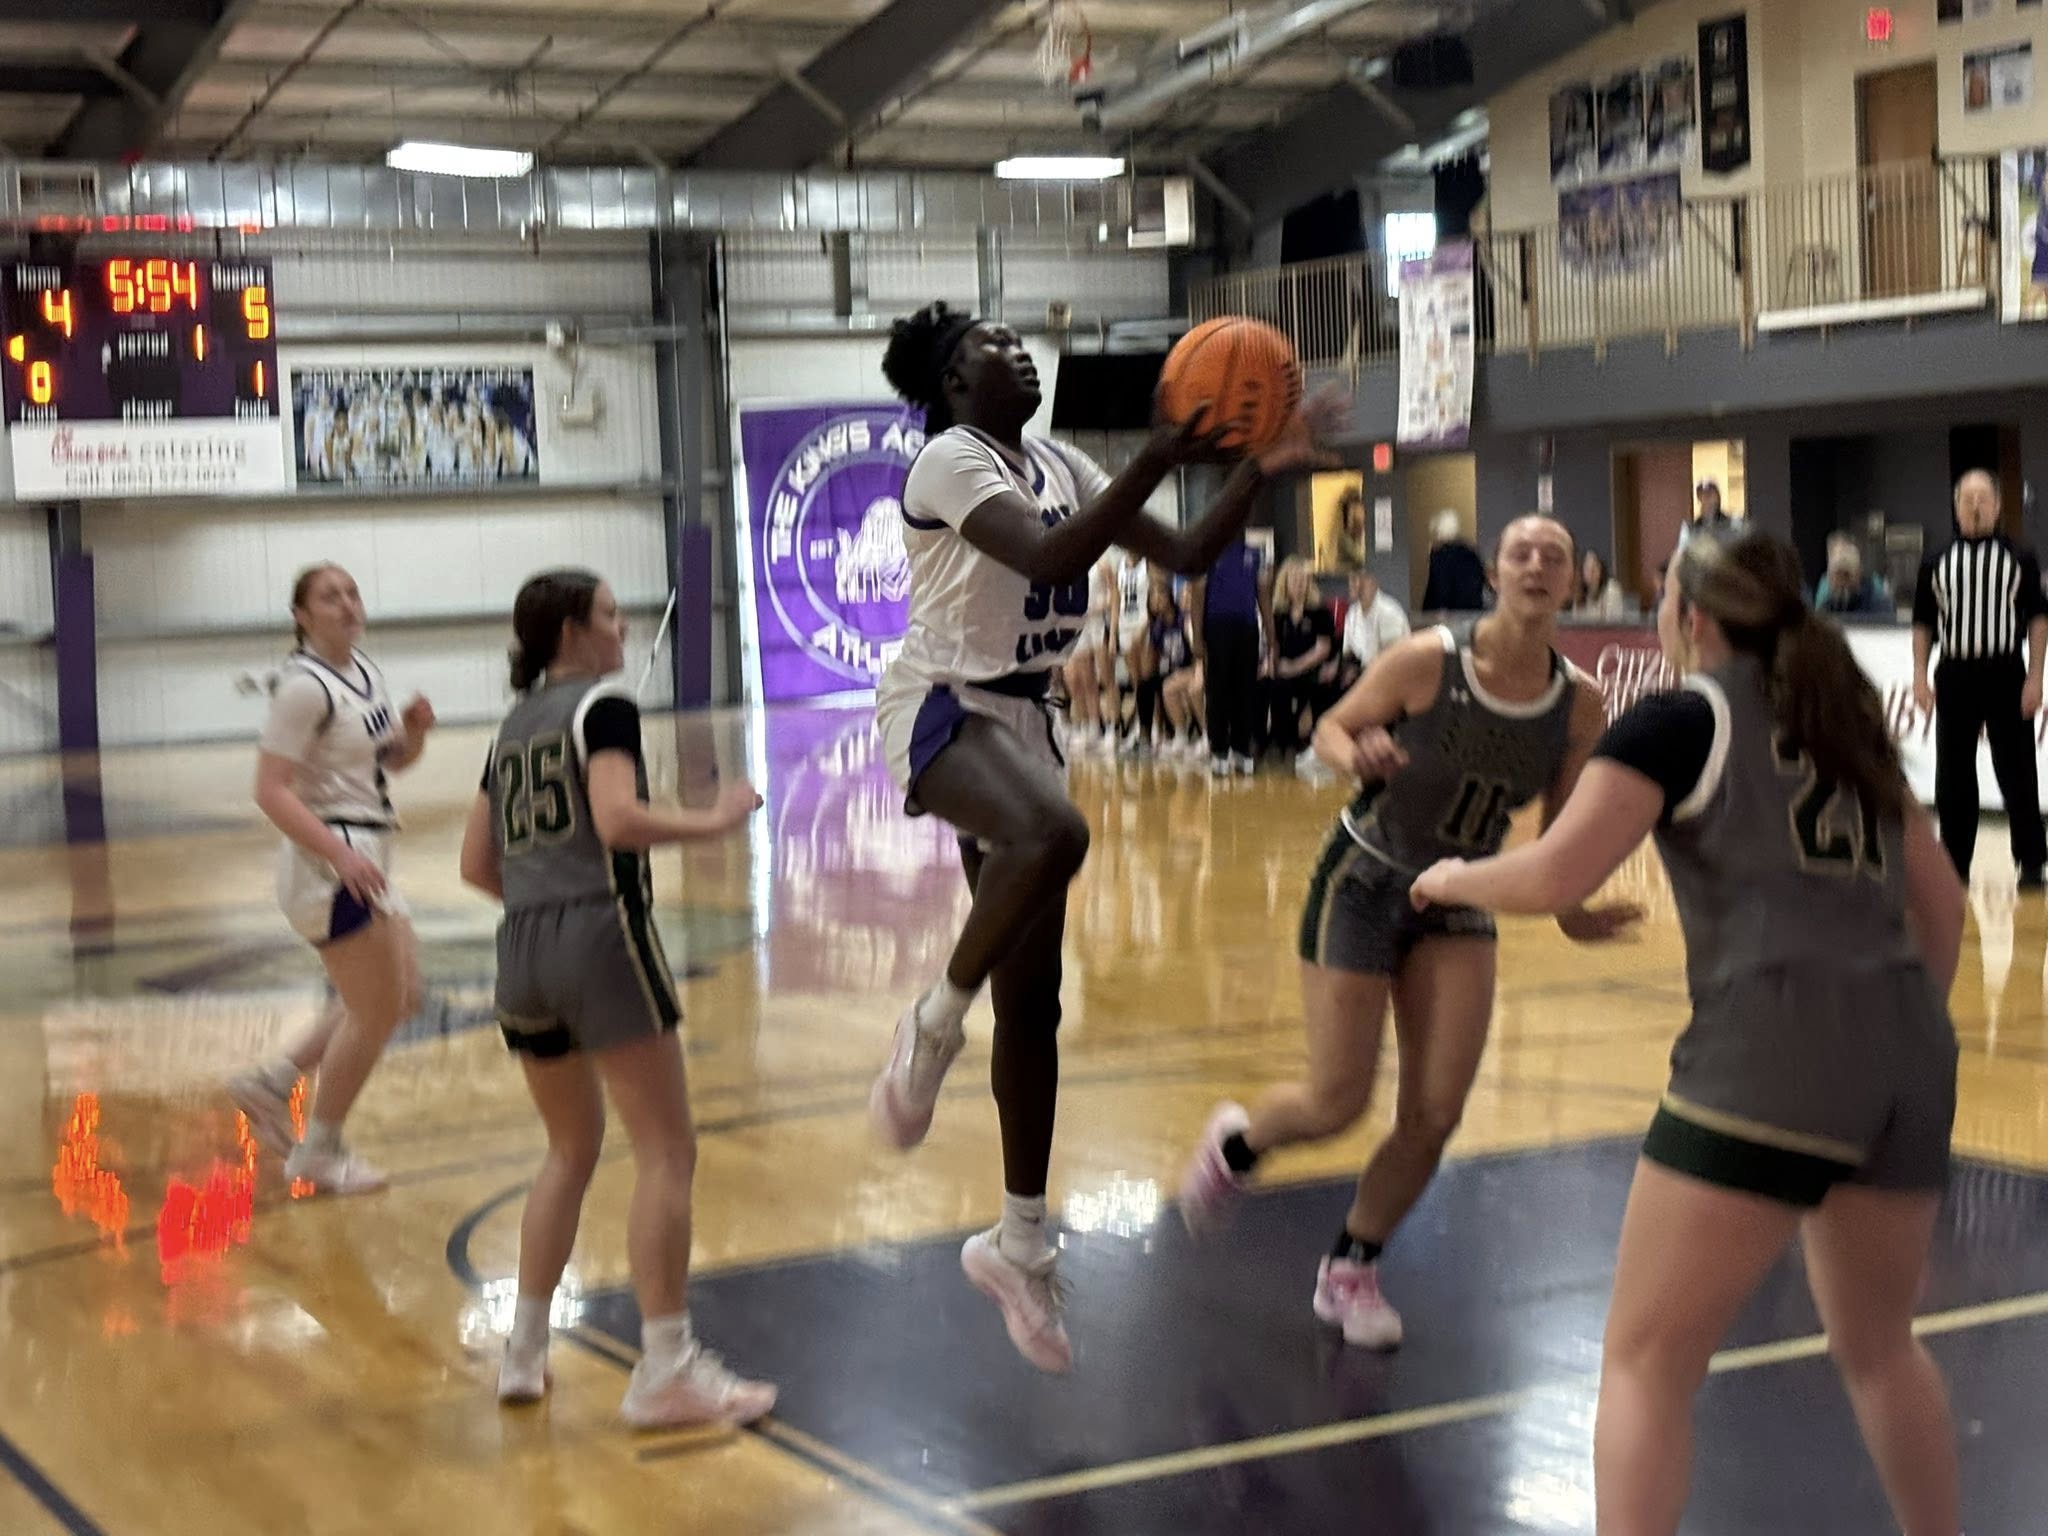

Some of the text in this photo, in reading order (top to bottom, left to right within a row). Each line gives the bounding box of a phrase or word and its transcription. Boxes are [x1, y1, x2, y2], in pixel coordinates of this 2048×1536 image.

[109, 259, 197, 312] 5:54
[45, 289, 72, 337] 4
[244, 287, 269, 338] 5
[31, 361, 51, 403] 0
[495, 730, 577, 856] 25
